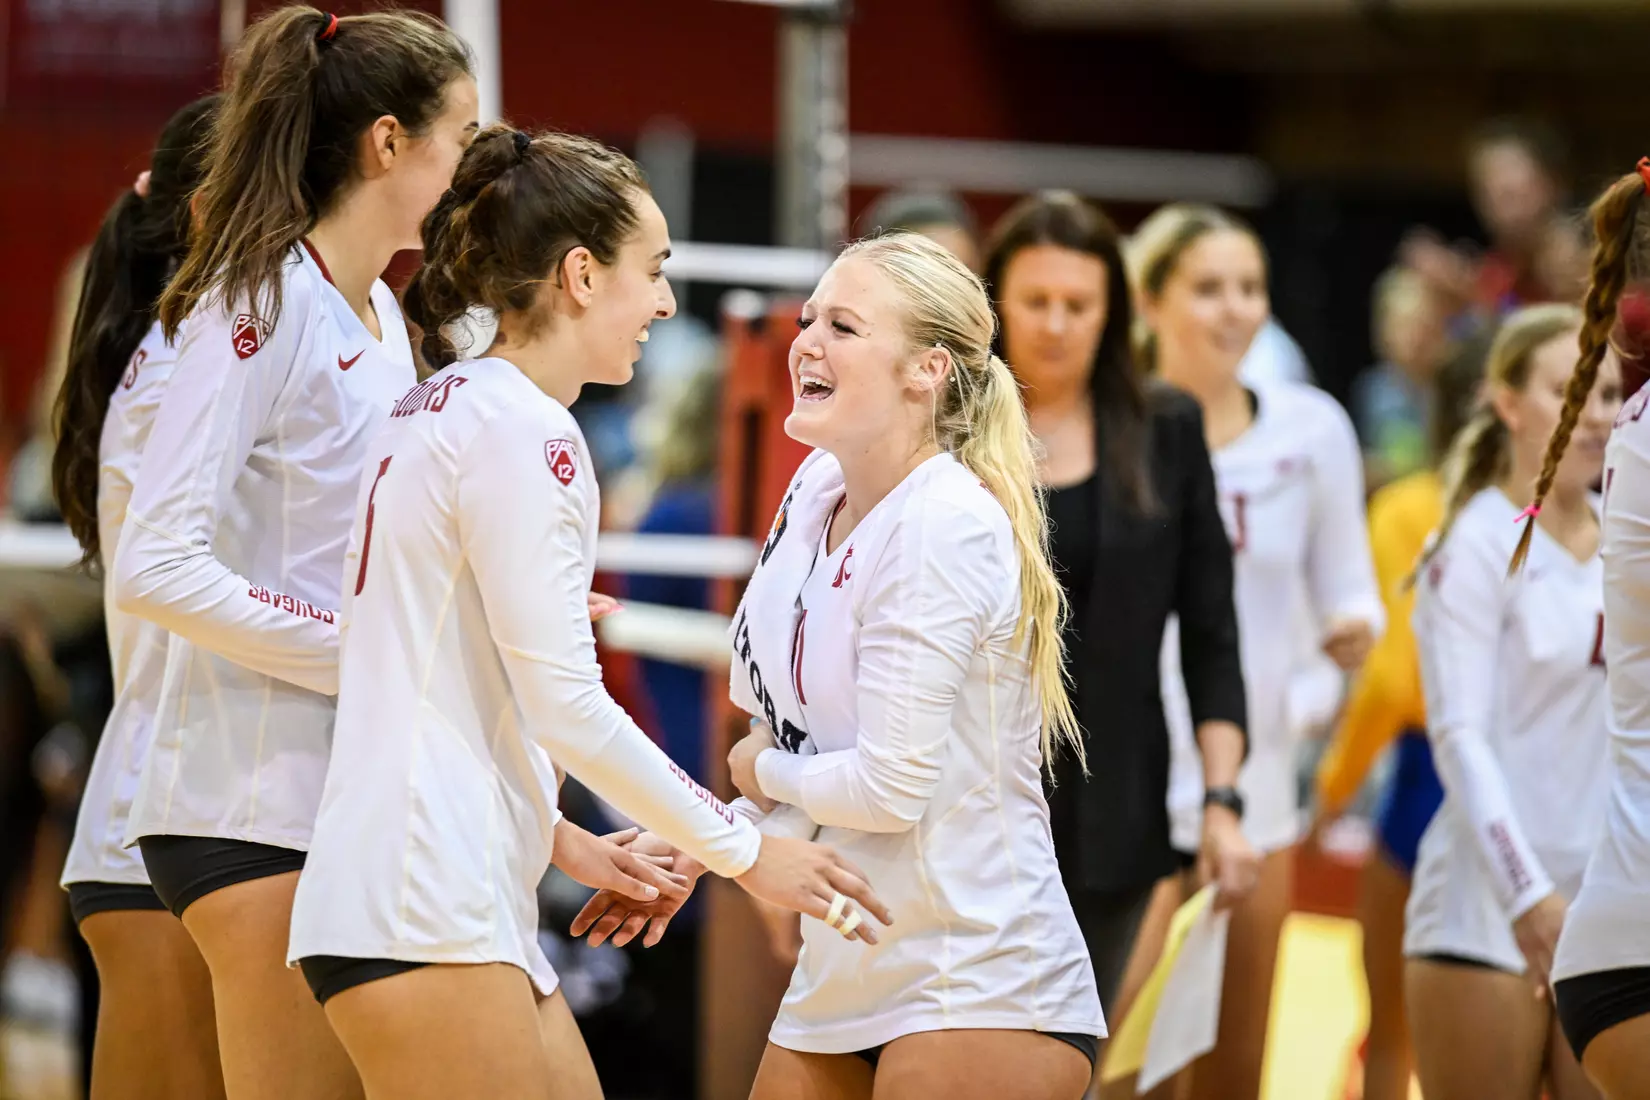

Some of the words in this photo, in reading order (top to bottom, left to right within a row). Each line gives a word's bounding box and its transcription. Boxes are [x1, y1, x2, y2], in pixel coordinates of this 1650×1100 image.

[237, 338, 252, 354] 12
[557, 463, 573, 479] 12
[248, 581, 334, 625] COUGARS
